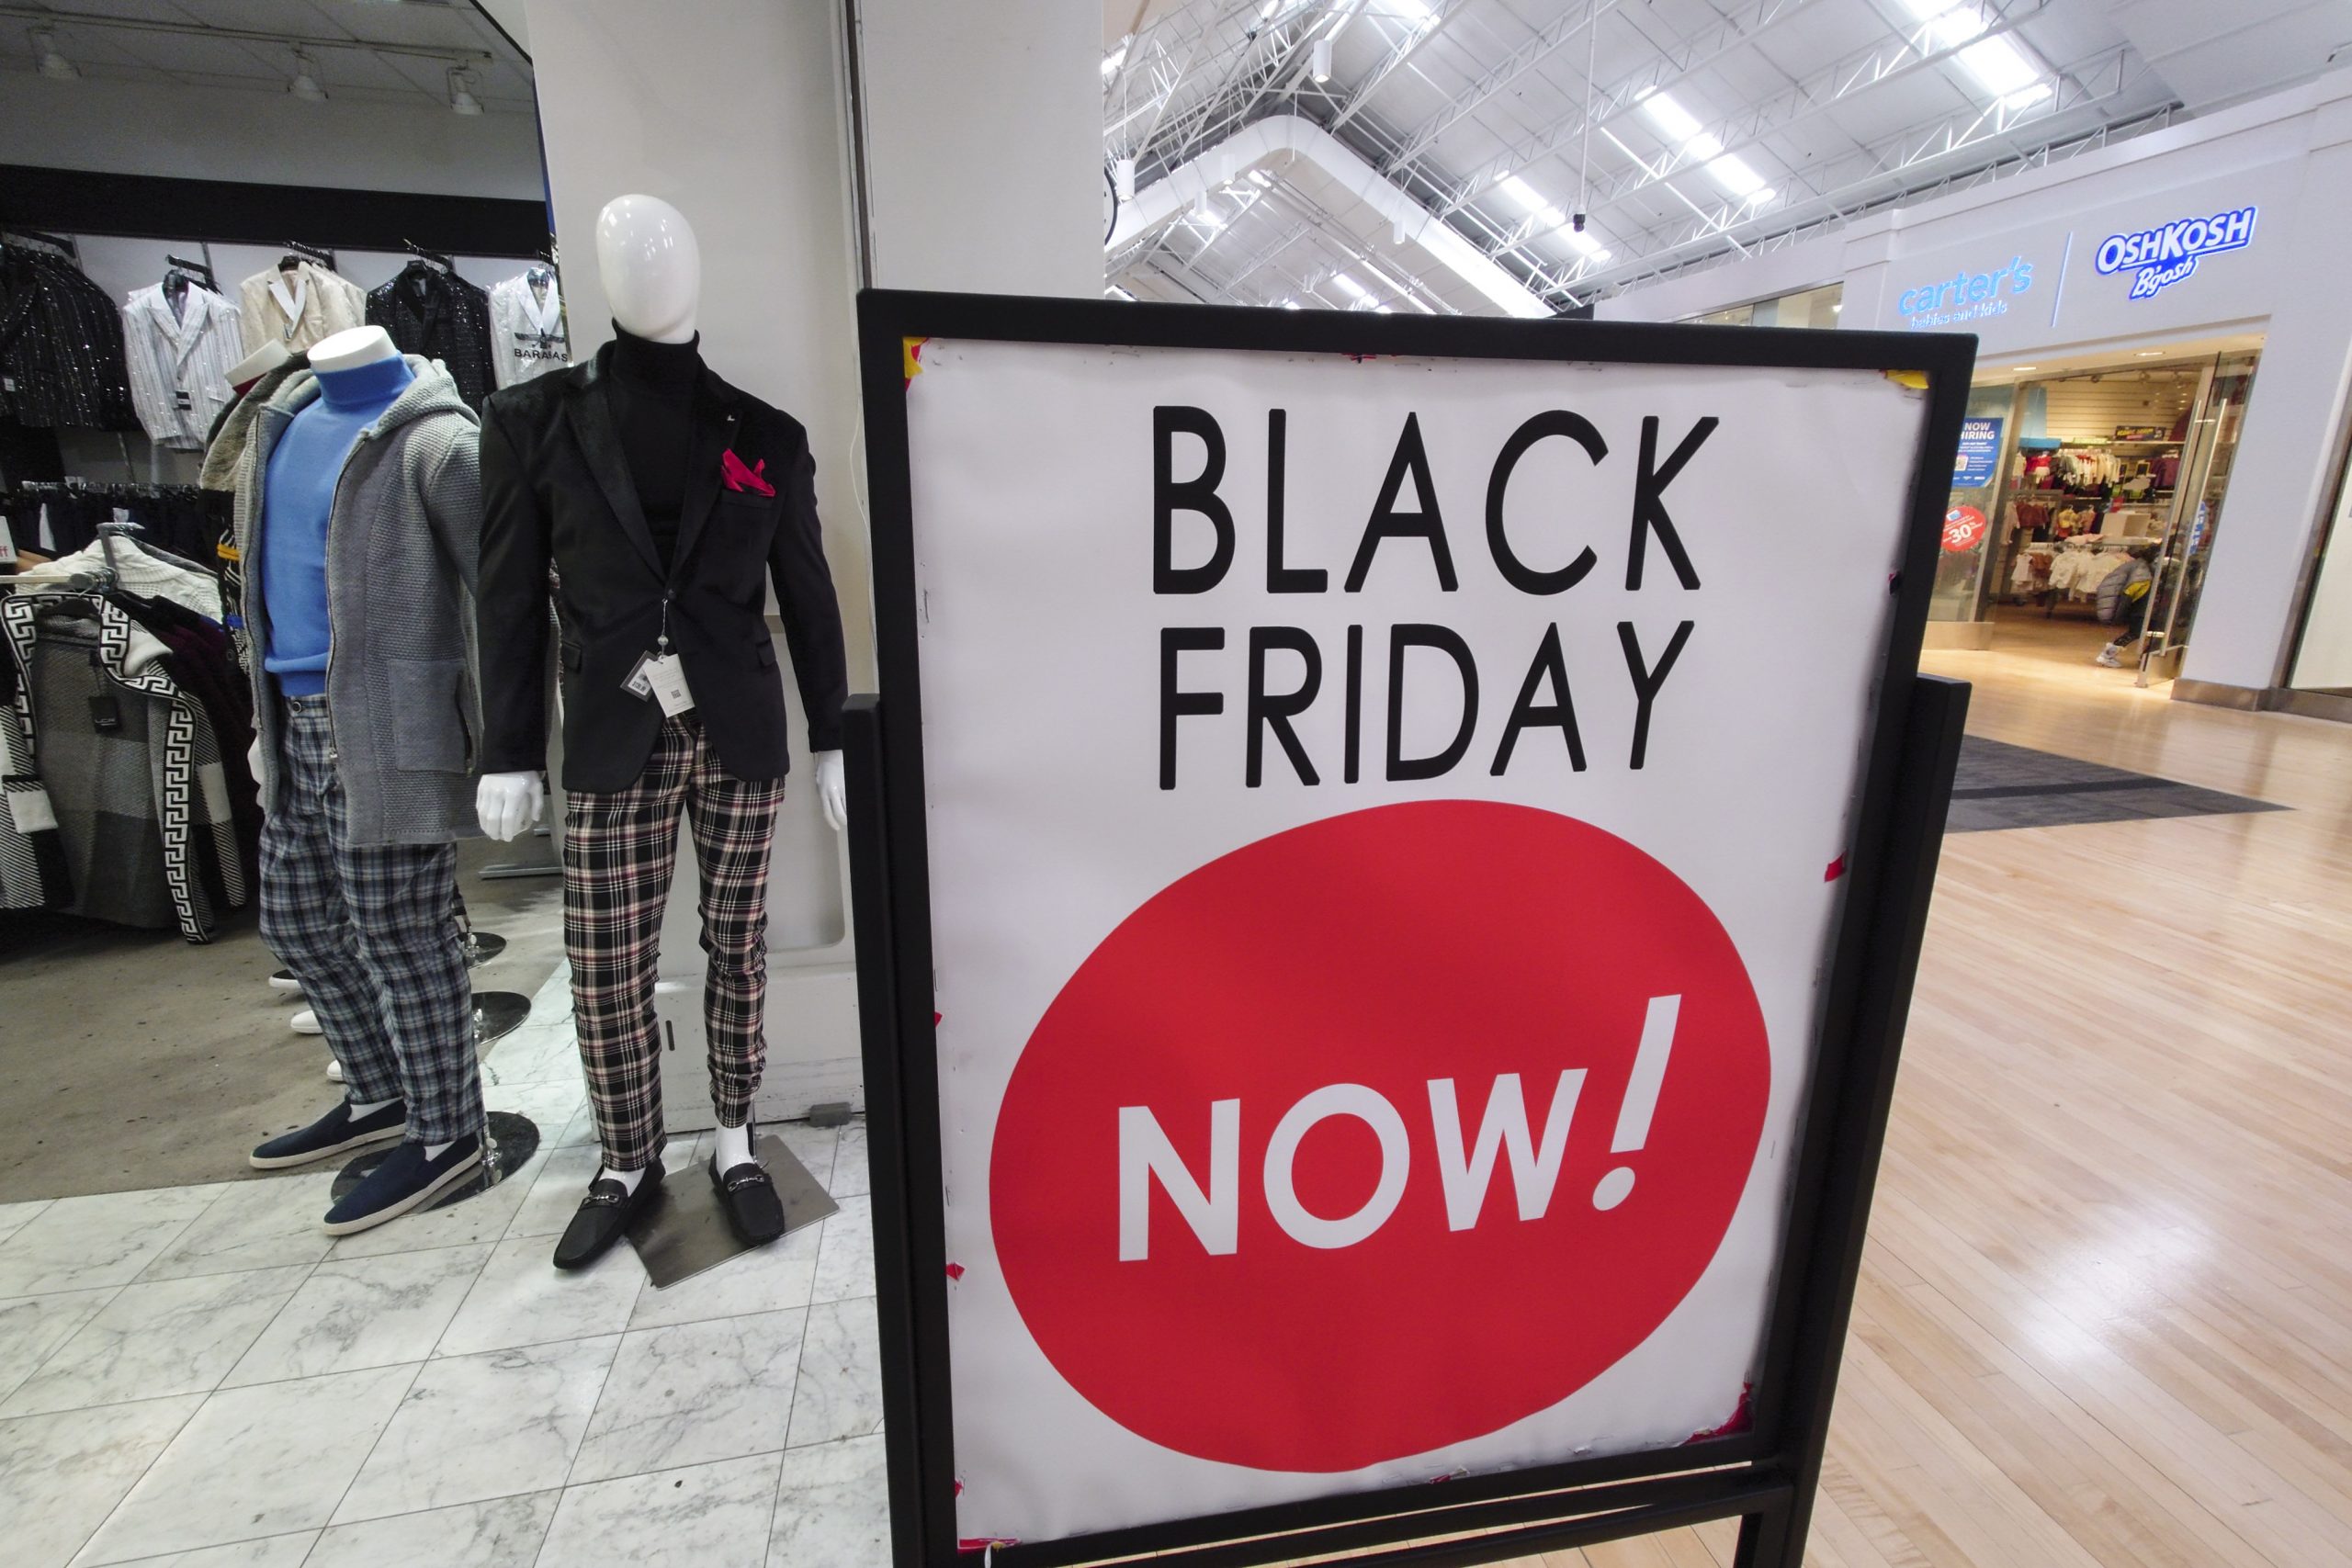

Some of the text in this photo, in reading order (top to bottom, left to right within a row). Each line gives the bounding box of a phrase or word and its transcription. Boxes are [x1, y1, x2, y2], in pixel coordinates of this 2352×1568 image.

[2097, 209, 2253, 274] OSHKOSH
[1898, 255, 2033, 316] carter's
[2131, 255, 2194, 297] B'gosh
[1979, 299, 2007, 317] kids
[1964, 422, 1991, 431] NOW
[1153, 406, 1718, 595] BLACK
[1160, 621, 1694, 790] FRIDAY
[1119, 995, 1681, 1261] NOW!
